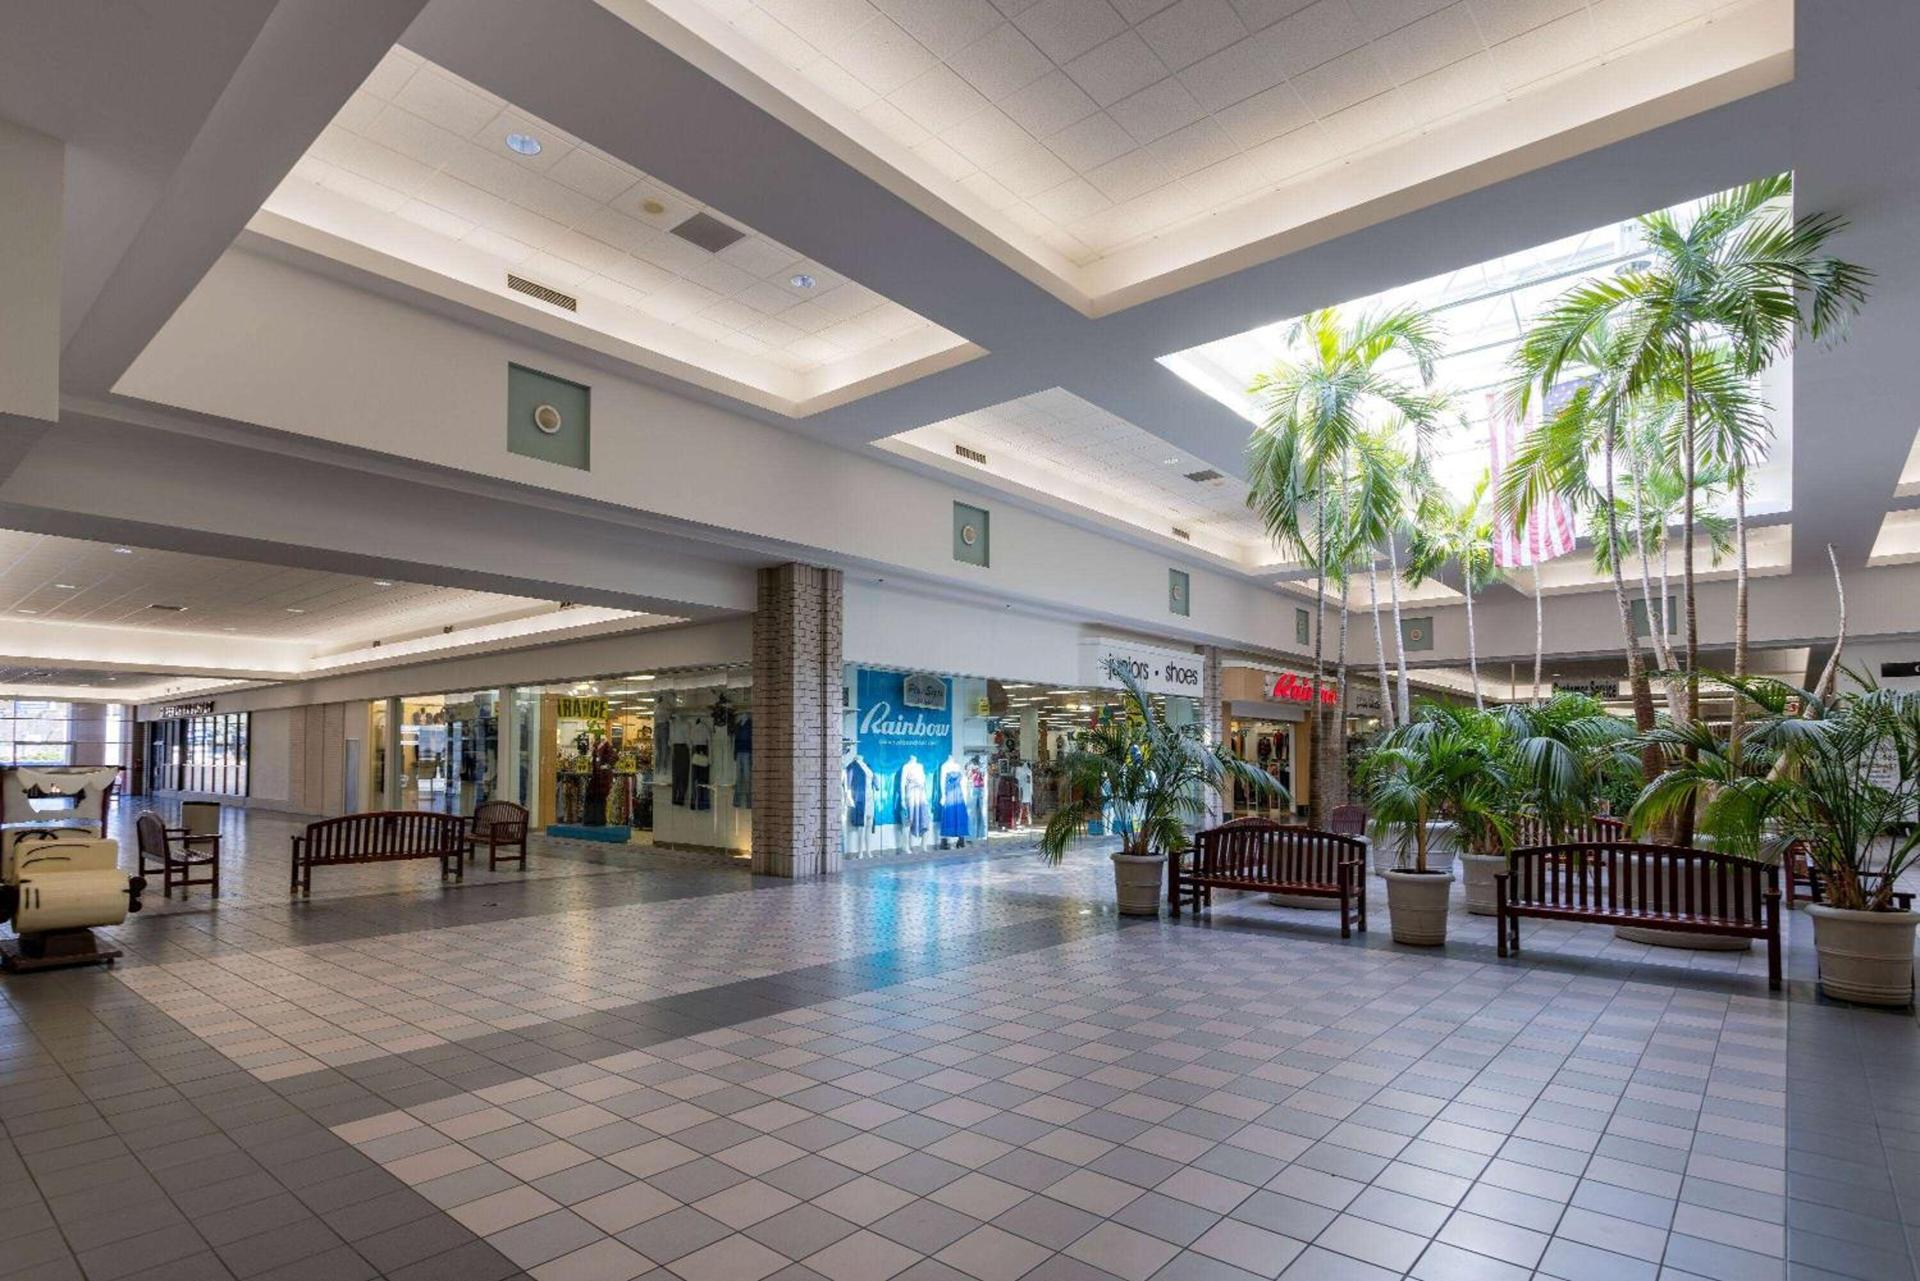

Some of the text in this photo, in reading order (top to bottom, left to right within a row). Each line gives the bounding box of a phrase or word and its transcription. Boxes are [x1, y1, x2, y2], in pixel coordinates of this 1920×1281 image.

[1165, 660, 1198, 685] shoes
[1273, 671, 1339, 705] Raibo
[860, 701, 950, 737] Rainbow
